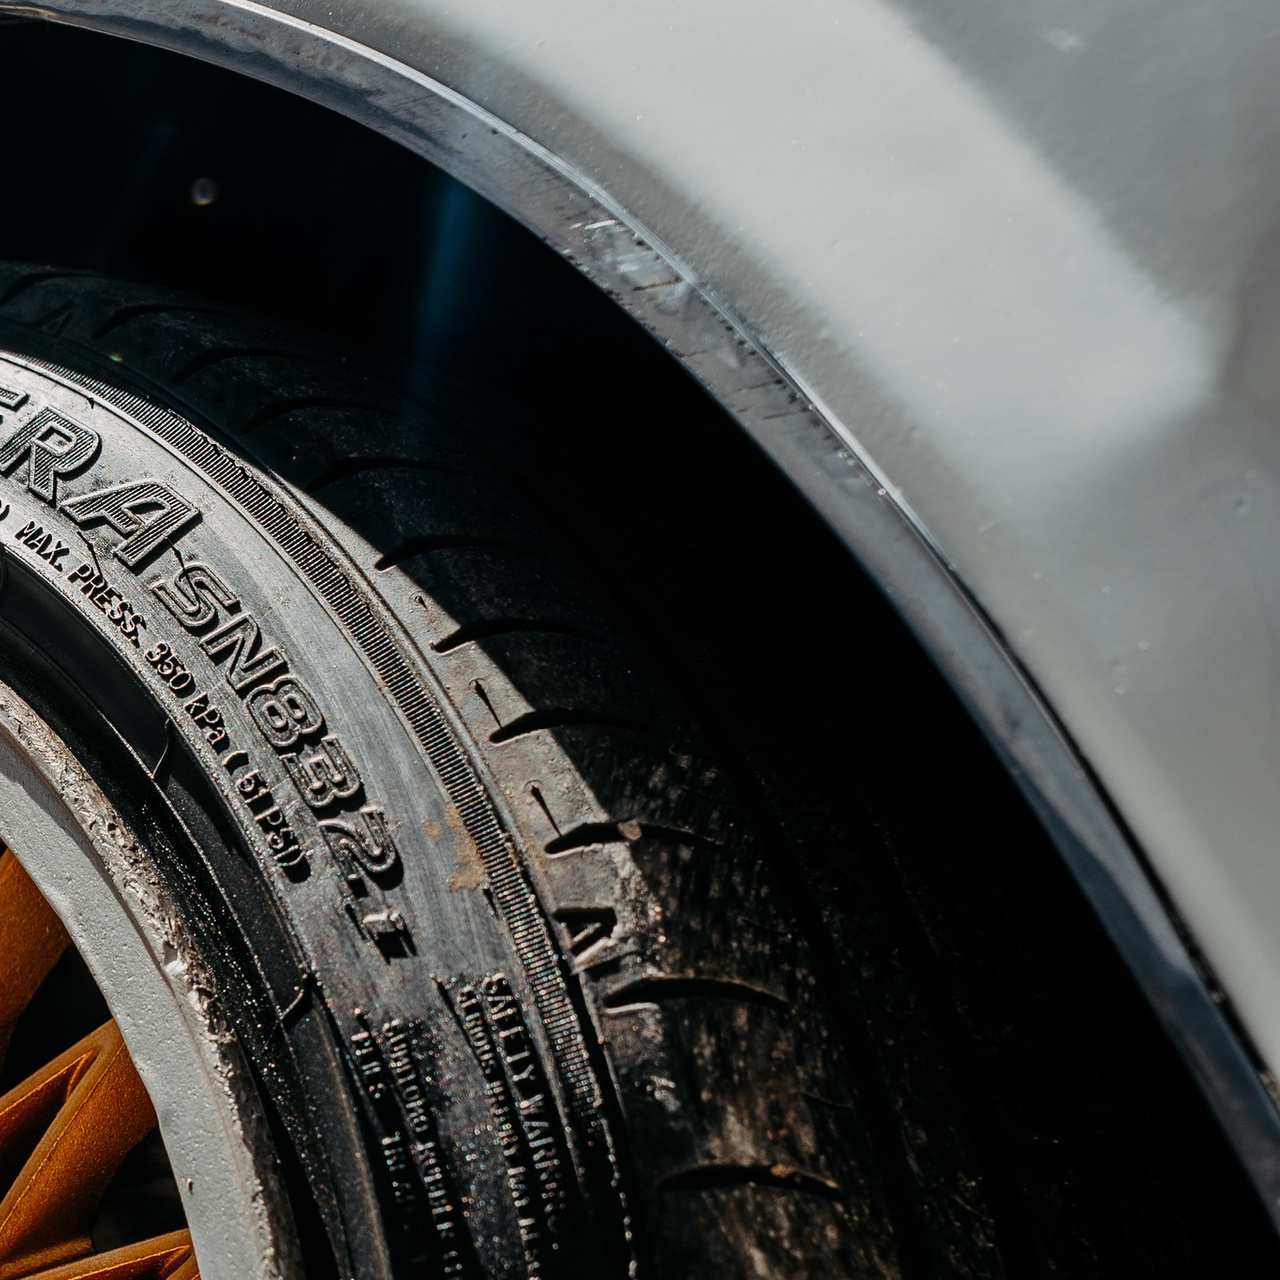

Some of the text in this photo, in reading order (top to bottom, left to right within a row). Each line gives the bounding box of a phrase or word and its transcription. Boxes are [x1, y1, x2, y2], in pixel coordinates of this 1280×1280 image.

[15, 520, 71, 572] MAX.
[67, 561, 148, 648] PRESS.
[145, 641, 196, 698] 350
